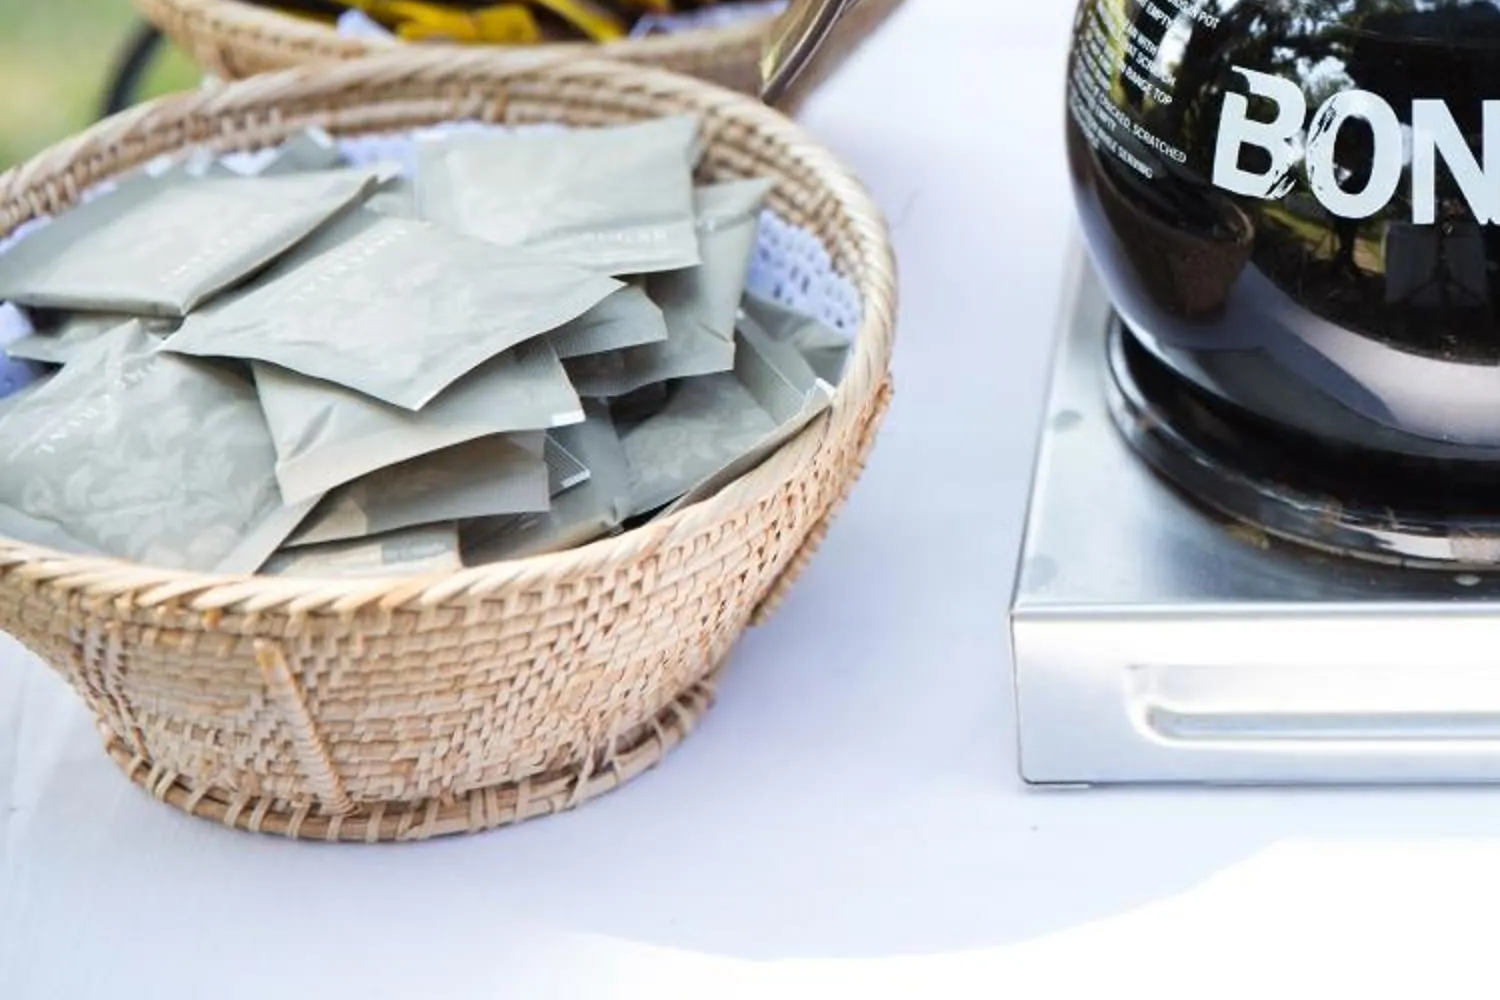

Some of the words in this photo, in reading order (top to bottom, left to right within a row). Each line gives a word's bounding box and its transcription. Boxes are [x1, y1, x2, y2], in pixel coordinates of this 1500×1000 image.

[1198, 9, 1220, 29] POT
[1154, 87, 1173, 105] TOP
[1132, 123, 1187, 163] SCRATCHED
